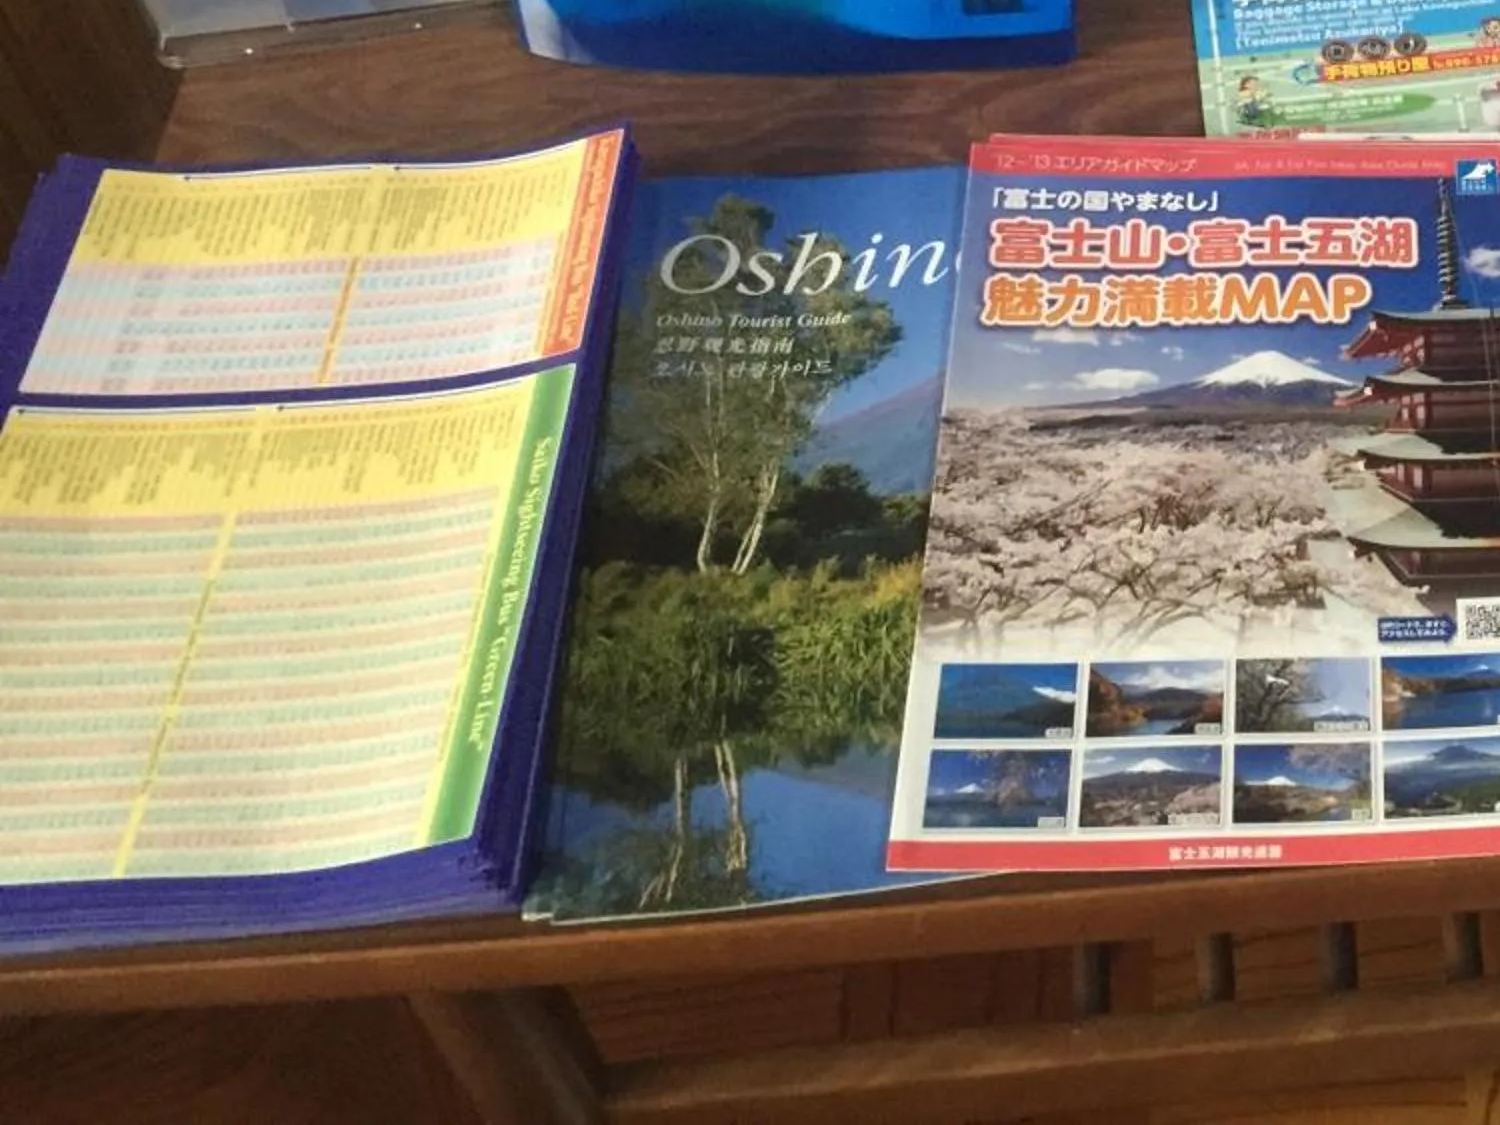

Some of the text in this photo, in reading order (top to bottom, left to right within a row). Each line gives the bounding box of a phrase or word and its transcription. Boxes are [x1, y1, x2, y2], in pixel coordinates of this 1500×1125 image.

[1233, 2, 1302, 22] Baggage
[992, 187, 1219, 212] 「富士の国やまなし」
[989, 214, 1420, 271] 富士山・富士五湖
[660, 231, 962, 298] Oshin
[728, 313, 793, 329] Tourist
[797, 311, 852, 328] Guide
[981, 272, 1373, 331] 魅力満載MAP
